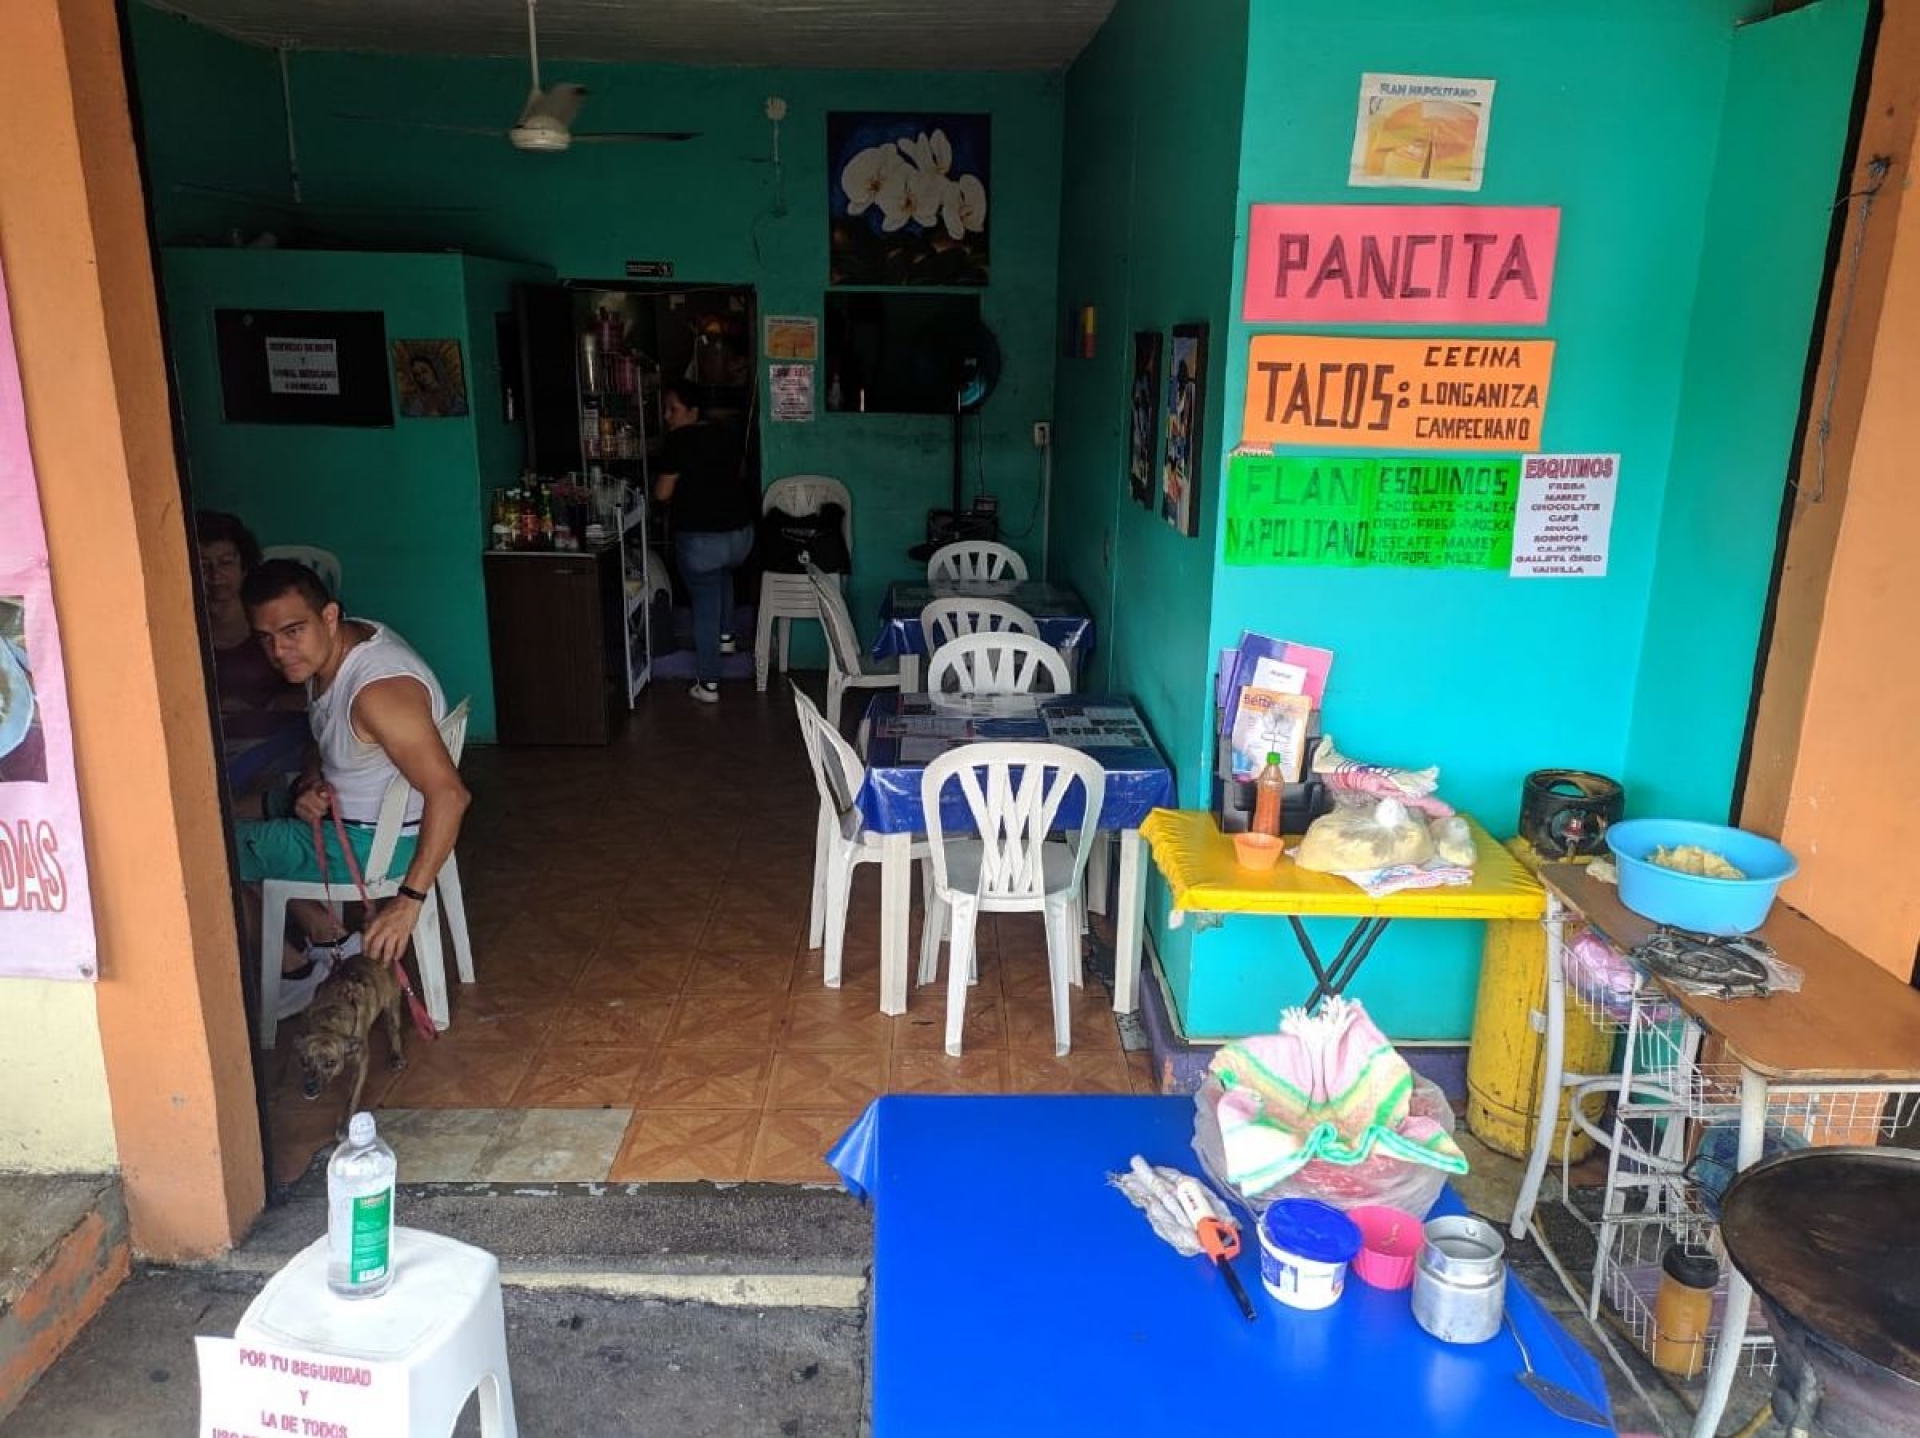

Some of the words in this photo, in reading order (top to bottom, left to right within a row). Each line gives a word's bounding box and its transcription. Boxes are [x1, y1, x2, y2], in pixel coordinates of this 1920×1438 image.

[1274, 233, 1538, 300] PANCITA
[1424, 345, 1521, 368] CECINA
[1420, 381, 1539, 409] LONGANIZA
[1415, 416, 1529, 441] CAMPECHANO
[1378, 466, 1508, 496] ESQUIMOS
[1525, 458, 1613, 479] ESQUIMOS
[1245, 465, 1362, 506] FLAN
[1226, 517, 1368, 559] NAPOLITANO
[239, 1348, 267, 1368] POR
[269, 1354, 289, 1373] TU
[291, 1360, 372, 1387] SEGURIDAD
[299, 1390, 310, 1407] Y
[261, 1410, 278, 1430] LA
[281, 1414, 299, 1434] DE
[302, 1418, 349, 1438] TODOS
